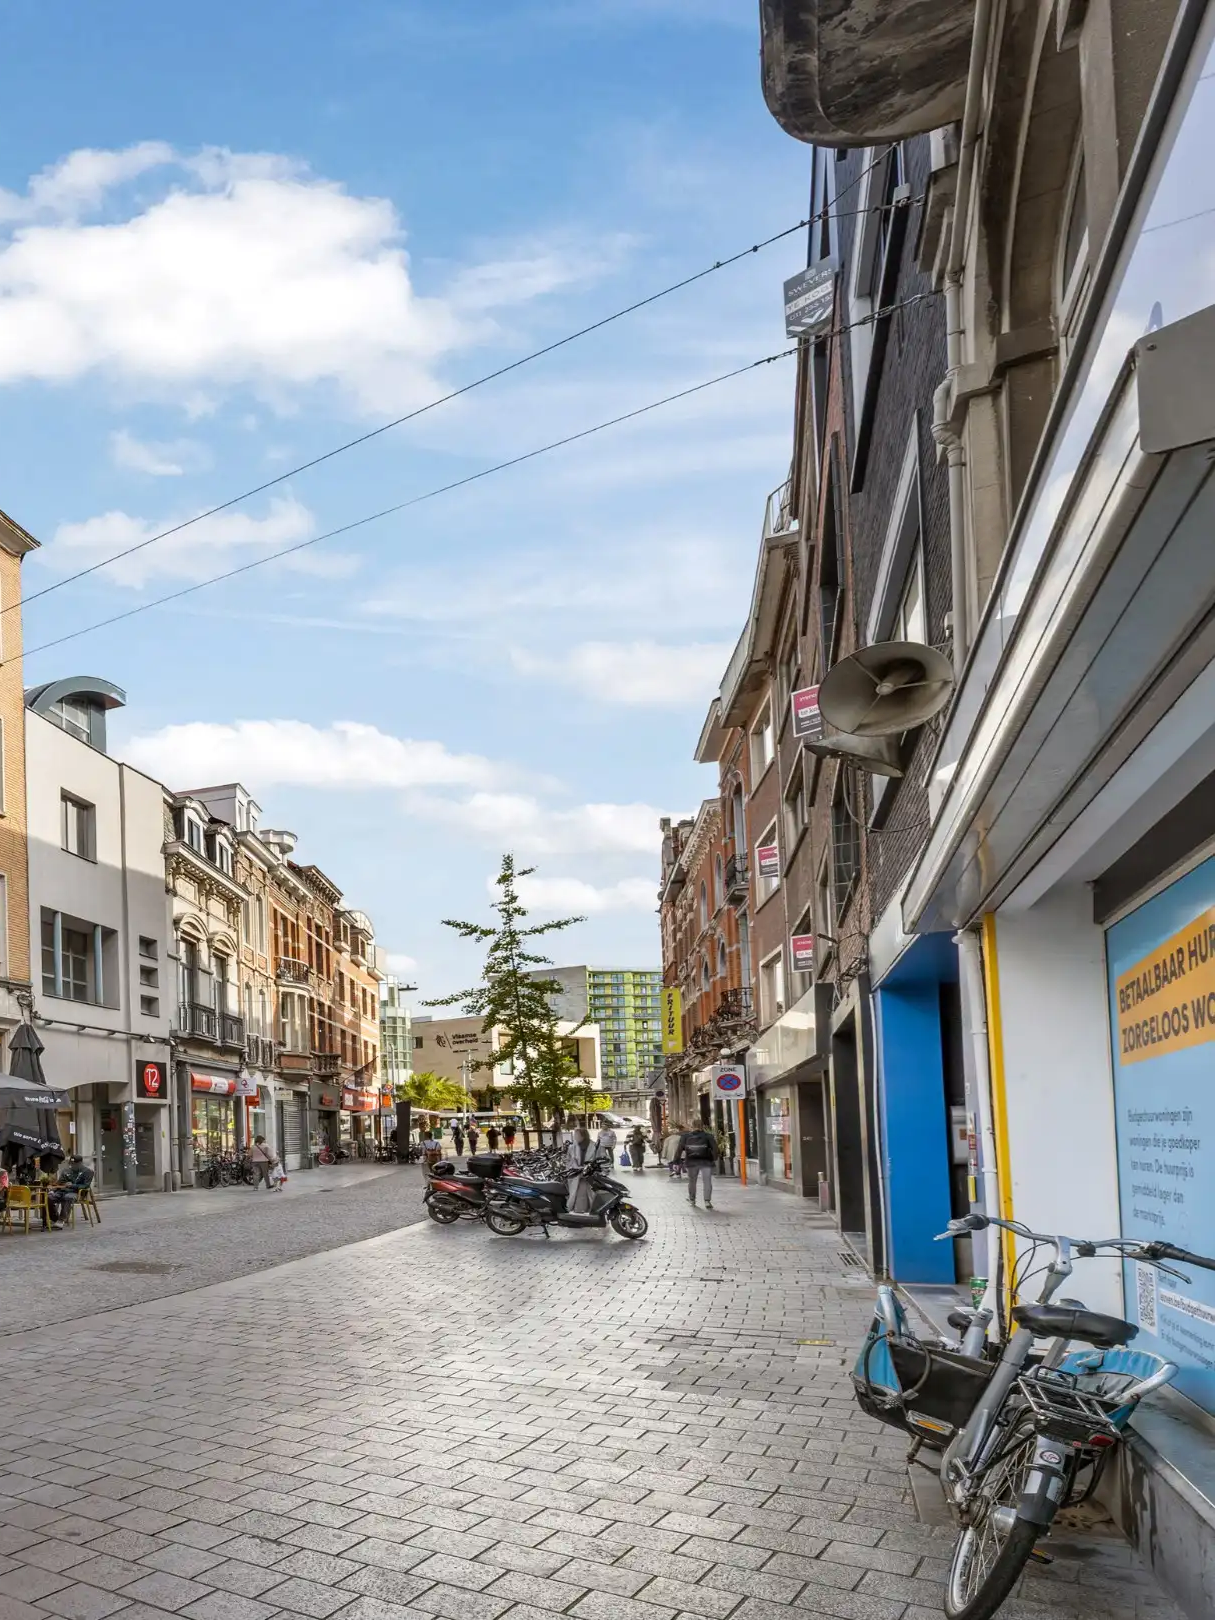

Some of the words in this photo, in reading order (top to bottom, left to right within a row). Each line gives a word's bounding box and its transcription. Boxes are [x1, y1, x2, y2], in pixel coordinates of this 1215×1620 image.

[1119, 946, 1186, 1014] BETAALBAAR
[1122, 1002, 1190, 1054] ZORGELOOS
[1168, 1133, 1201, 1154] goedkoper
